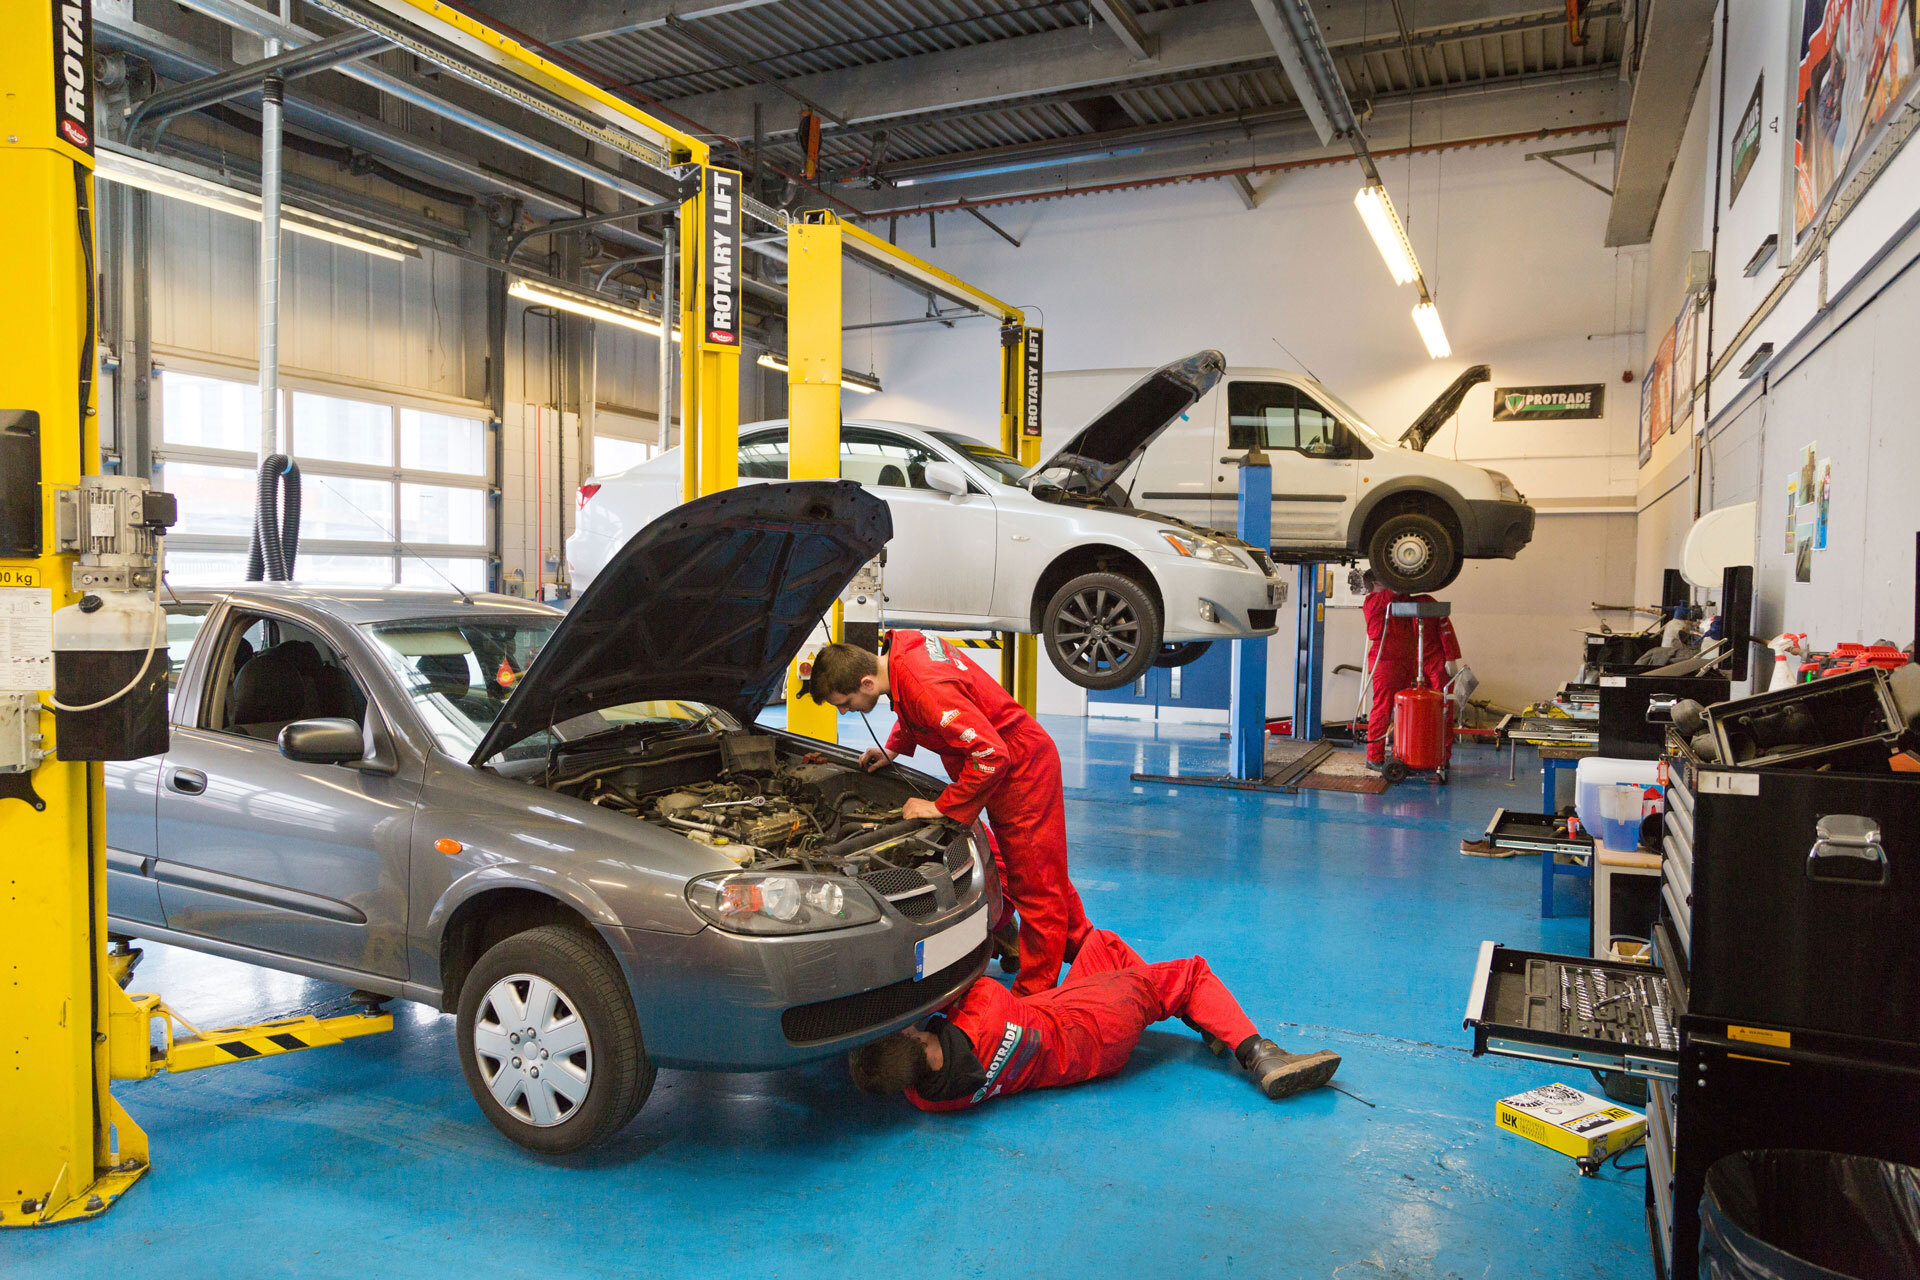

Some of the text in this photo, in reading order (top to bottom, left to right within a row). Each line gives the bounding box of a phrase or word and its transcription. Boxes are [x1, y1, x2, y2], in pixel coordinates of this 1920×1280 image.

[62, 0, 85, 122] ROTA
[713, 171, 732, 330] ROTARY LIFT
[1028, 329, 1039, 362] LIFT
[1027, 365, 1039, 427] ROTARY
[1525, 392, 1592, 405] PROTRADE
[16, 572, 33, 586] kg
